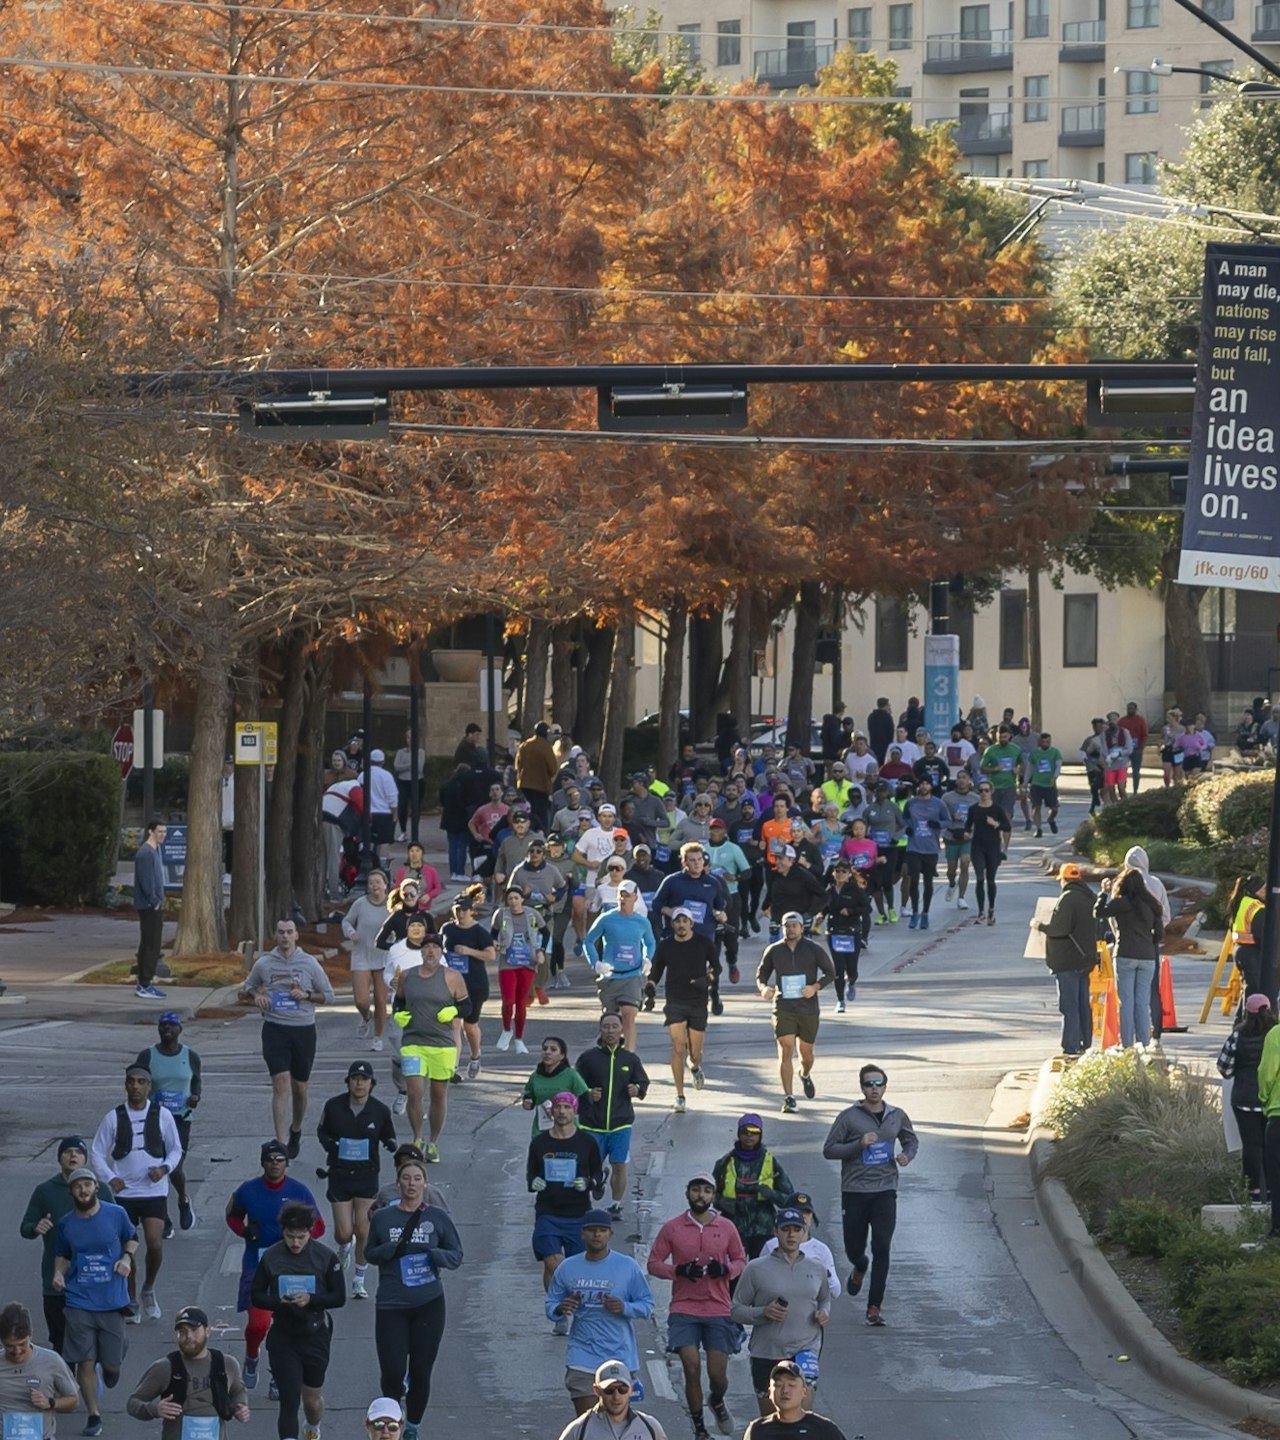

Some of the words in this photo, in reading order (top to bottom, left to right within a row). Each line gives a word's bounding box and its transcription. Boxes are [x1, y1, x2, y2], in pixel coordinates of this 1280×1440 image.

[1219, 261, 1230, 275] A
[1234, 265, 1267, 278] man
[1217, 284, 1251, 300] may
[1253, 284, 1280, 302] die,
[1216, 303, 1270, 319] nations
[1214, 327, 1246, 342] may
[1249, 326, 1277, 342] rise
[1212, 346, 1239, 360] and
[1244, 347, 1271, 365] fall,
[1211, 366, 1235, 381] but
[1209, 386, 1248, 413] an
[1207, 417, 1275, 454] idea
[1203, 454, 1278, 491] lives
[1200, 492, 1249, 520] on.
[1194, 561, 1269, 581] jfk.org/60
[934, 675, 949, 696] 3
[113, 741, 133, 762] STOP
